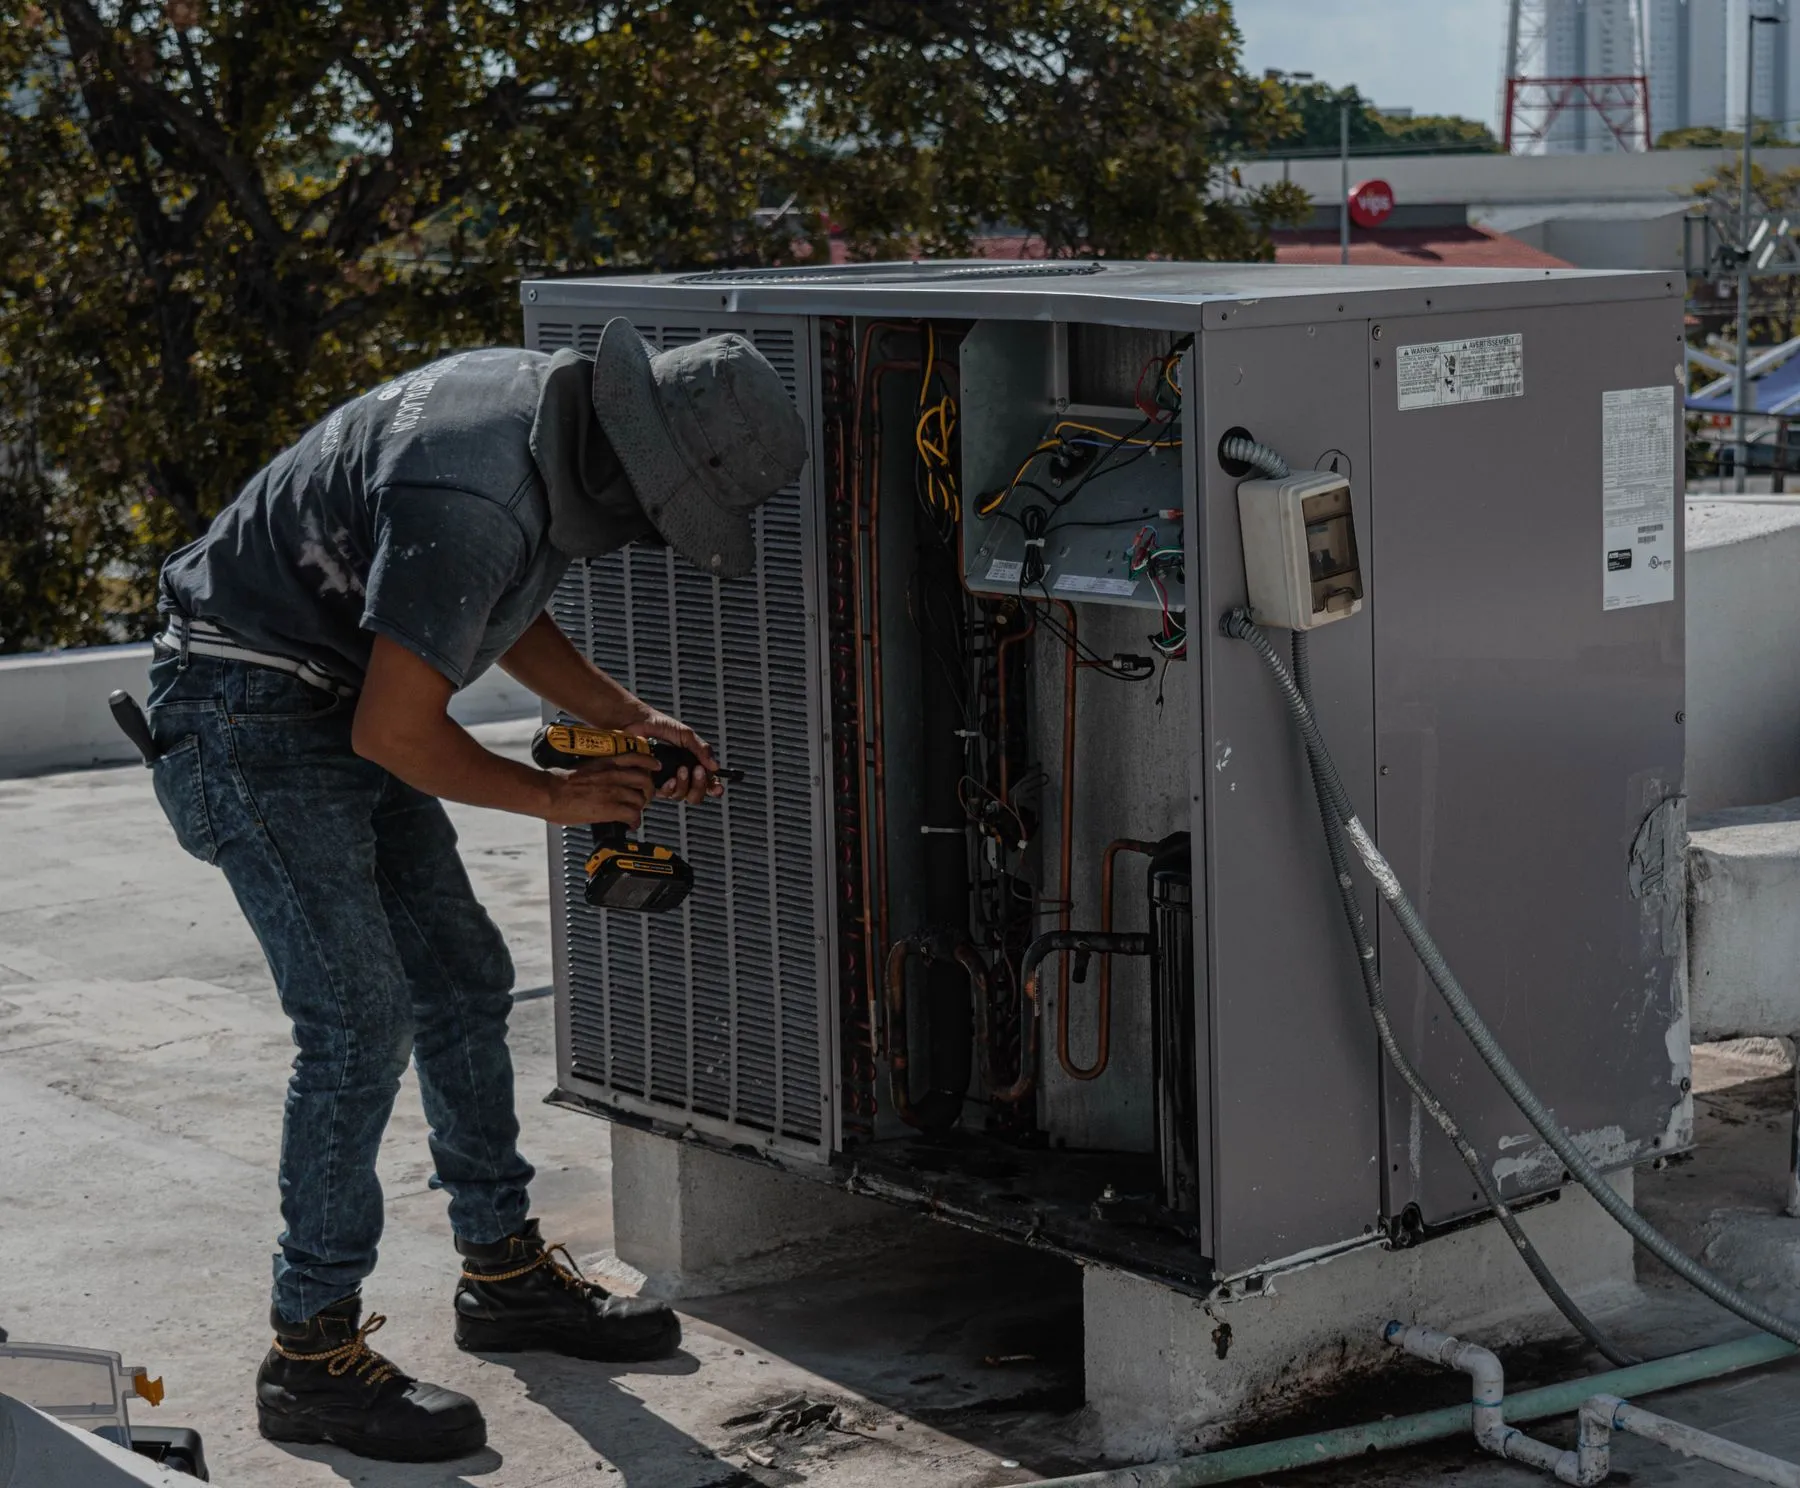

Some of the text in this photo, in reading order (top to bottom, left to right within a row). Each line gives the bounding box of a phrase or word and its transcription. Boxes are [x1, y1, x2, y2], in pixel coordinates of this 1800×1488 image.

[1356, 192, 1389, 216] vips
[1468, 337, 1515, 349] AVERTISSEMENT
[1410, 345, 1440, 355] WARNING
